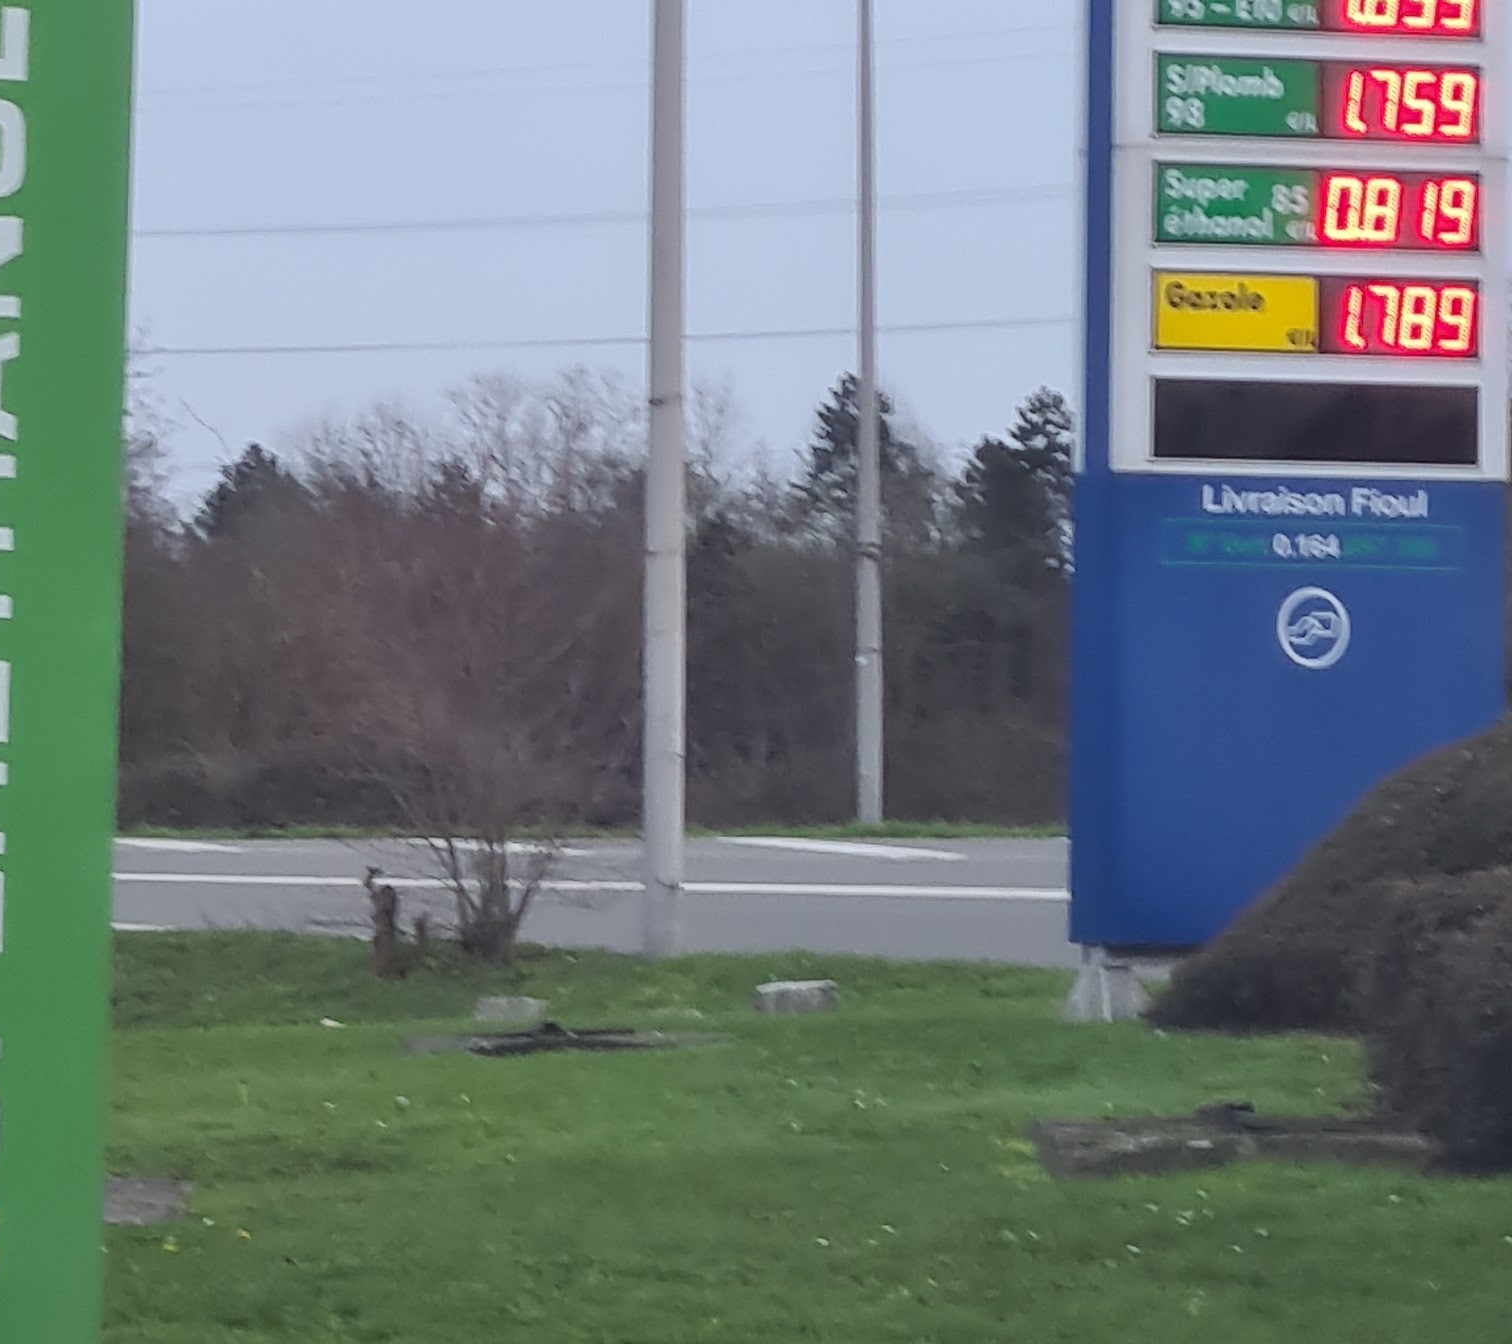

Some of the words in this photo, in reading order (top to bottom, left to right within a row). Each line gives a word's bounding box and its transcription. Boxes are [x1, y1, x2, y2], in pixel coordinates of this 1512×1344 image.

[1165, 280, 1266, 312] Gazole
[1201, 484, 1347, 517] Livraison
[1350, 487, 1429, 519] Fioul
